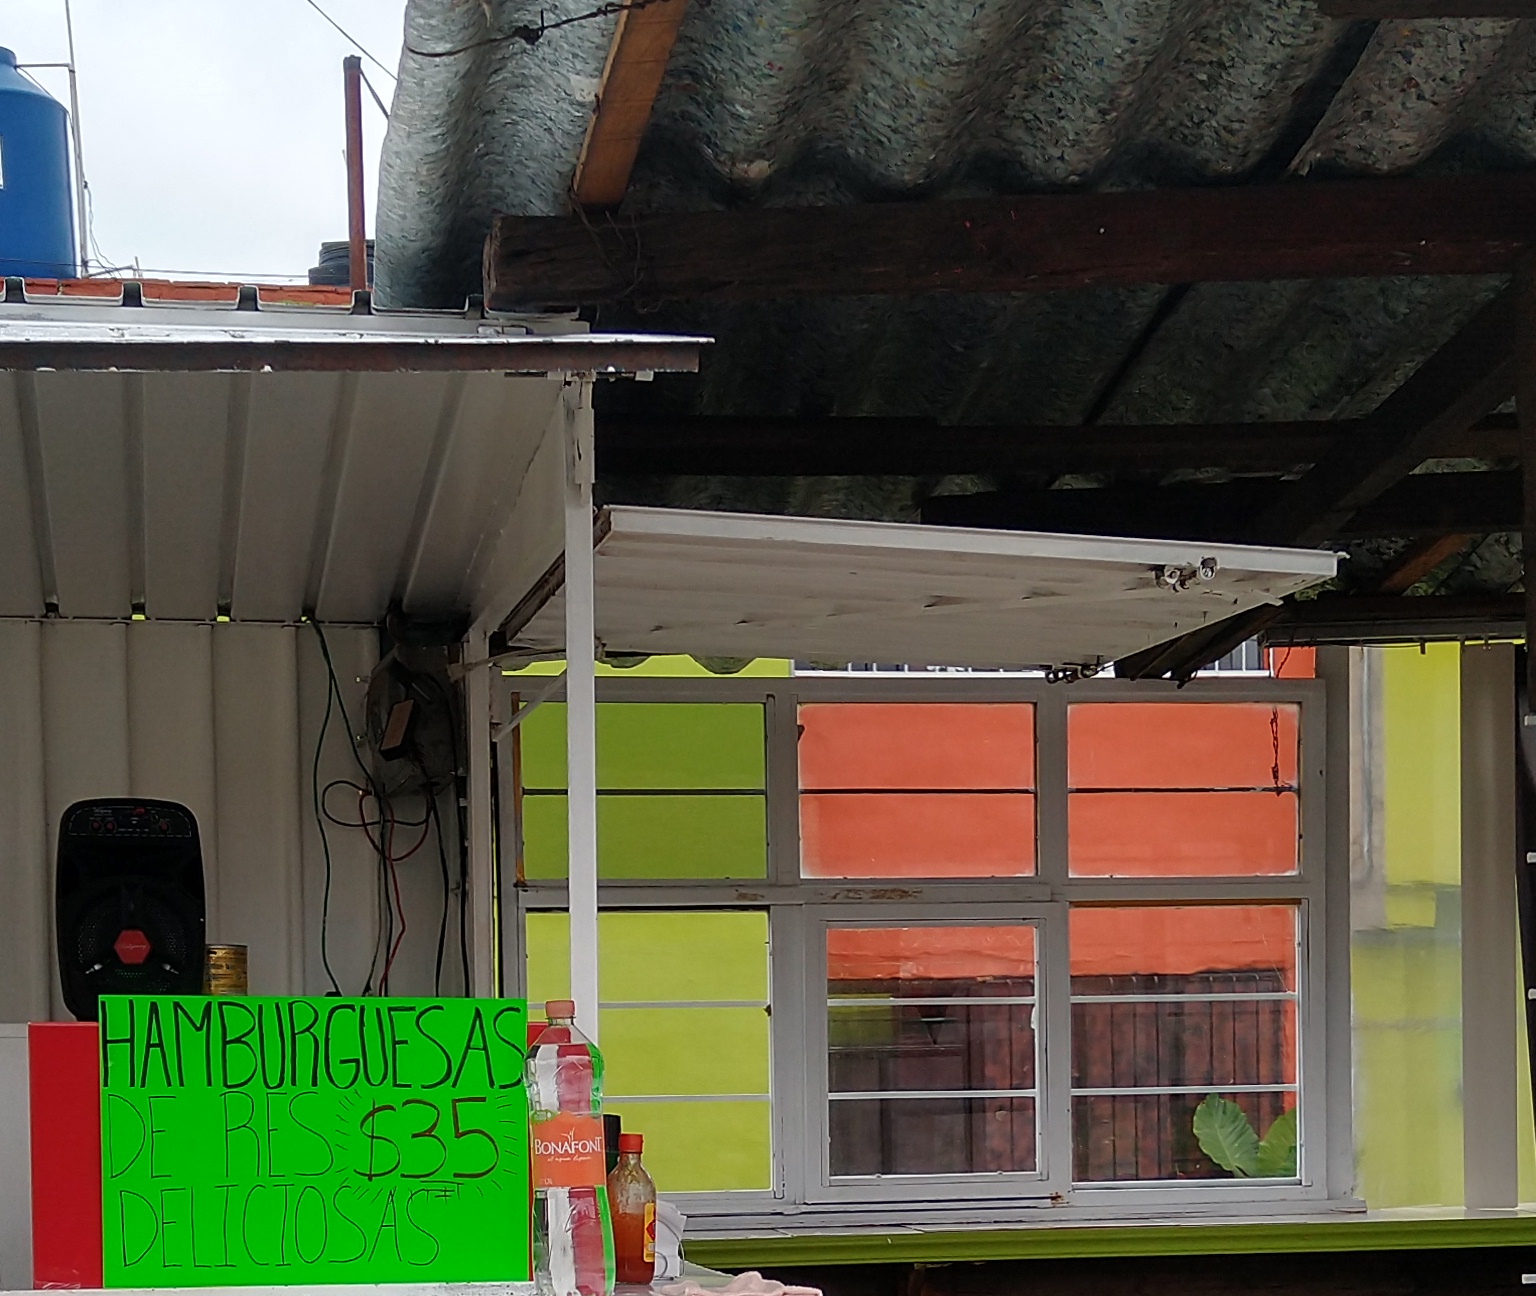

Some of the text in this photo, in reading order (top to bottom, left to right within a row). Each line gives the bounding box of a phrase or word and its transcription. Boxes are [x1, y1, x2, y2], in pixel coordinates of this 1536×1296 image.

[100, 999, 524, 1090] HAMBURGUESAS
[108, 1091, 500, 1182] DE RES $35
[534, 1136, 602, 1155] BONAFONT
[119, 1183, 440, 1269] DELICIOSAS
